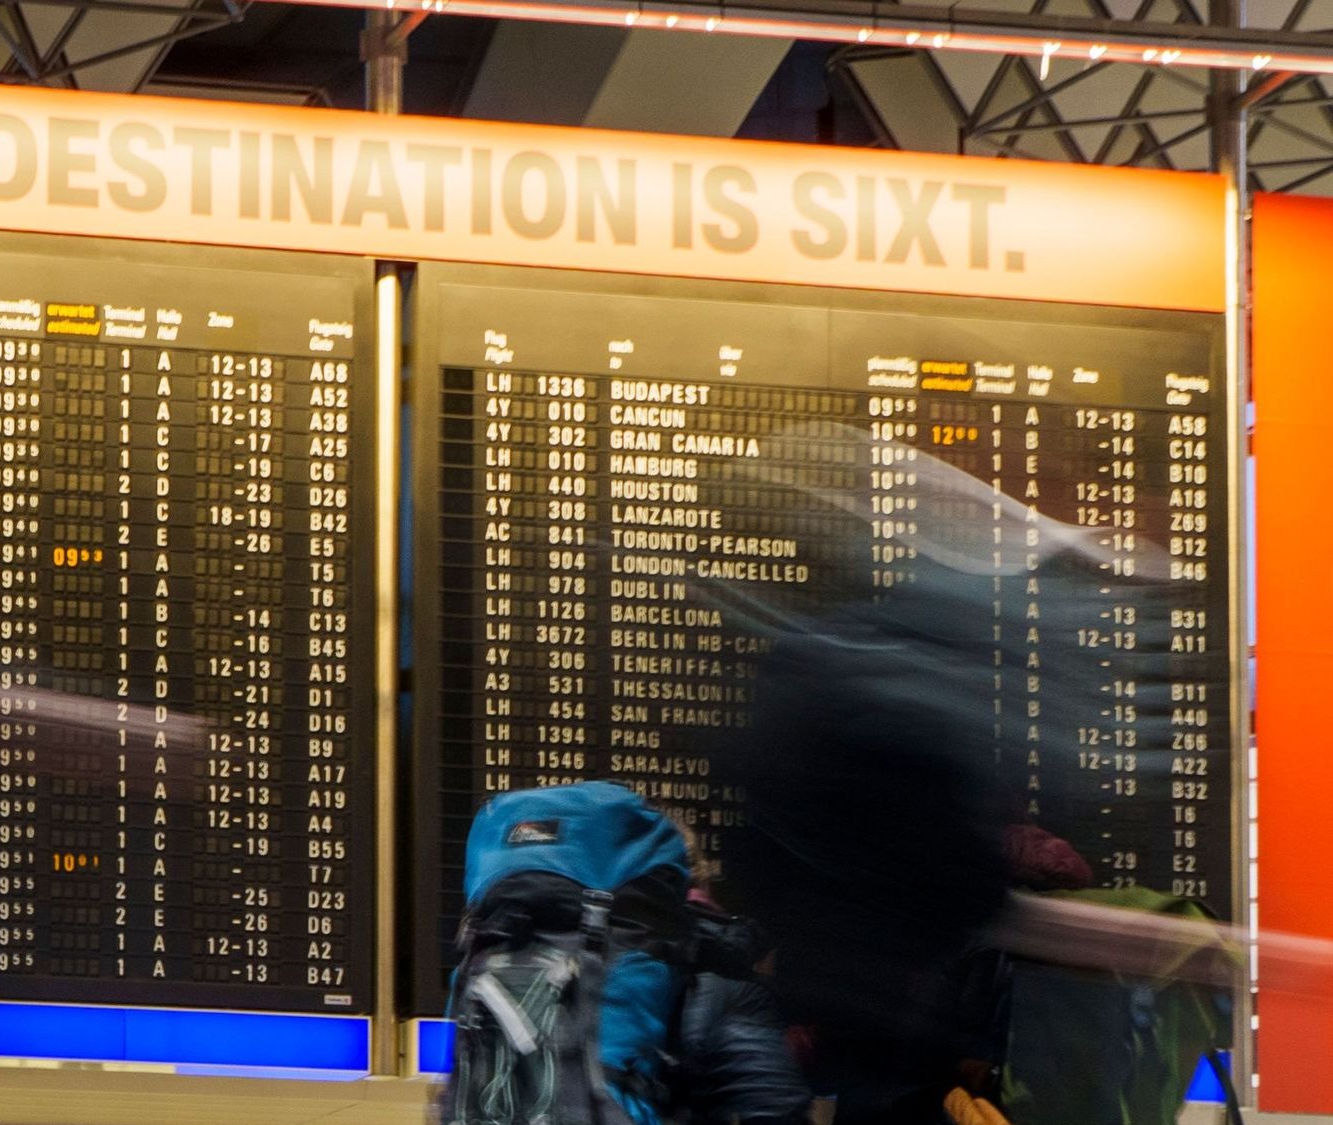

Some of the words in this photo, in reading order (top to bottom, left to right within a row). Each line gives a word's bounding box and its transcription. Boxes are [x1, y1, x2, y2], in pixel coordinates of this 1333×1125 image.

[672, 162, 758, 254] IS
[790, 171, 1025, 272] SIXT.
[310, 362, 347, 382] A68
[538, 376, 585, 397] 1336
[611, 380, 709, 404] BUDAPEST
[486, 398, 510, 416] 4Y
[549, 401, 585, 421] 010
[611, 405, 685, 427] CANCUN
[549, 427, 585, 446] 302
[611, 430, 660, 450] GRAN
[673, 434, 759, 457] CANARIA
[549, 451, 585, 471] 010
[611, 455, 696, 478] HAMBURG
[549, 476, 585, 495] 440
[611, 480, 697, 502] HOUSTON
[549, 501, 585, 520] 308
[612, 505, 720, 528] LANZAROTE
[486, 523, 509, 541] AC
[549, 526, 583, 544] 841
[612, 529, 795, 557] TORONTO-PEARSON
[611, 555, 807, 585] LONDON-CANCELLED
[611, 580, 685, 600] DUBLIN
[539, 601, 584, 620] 1126
[611, 605, 720, 626] BARCELONA
[611, 755, 710, 775] SARAJEVO
